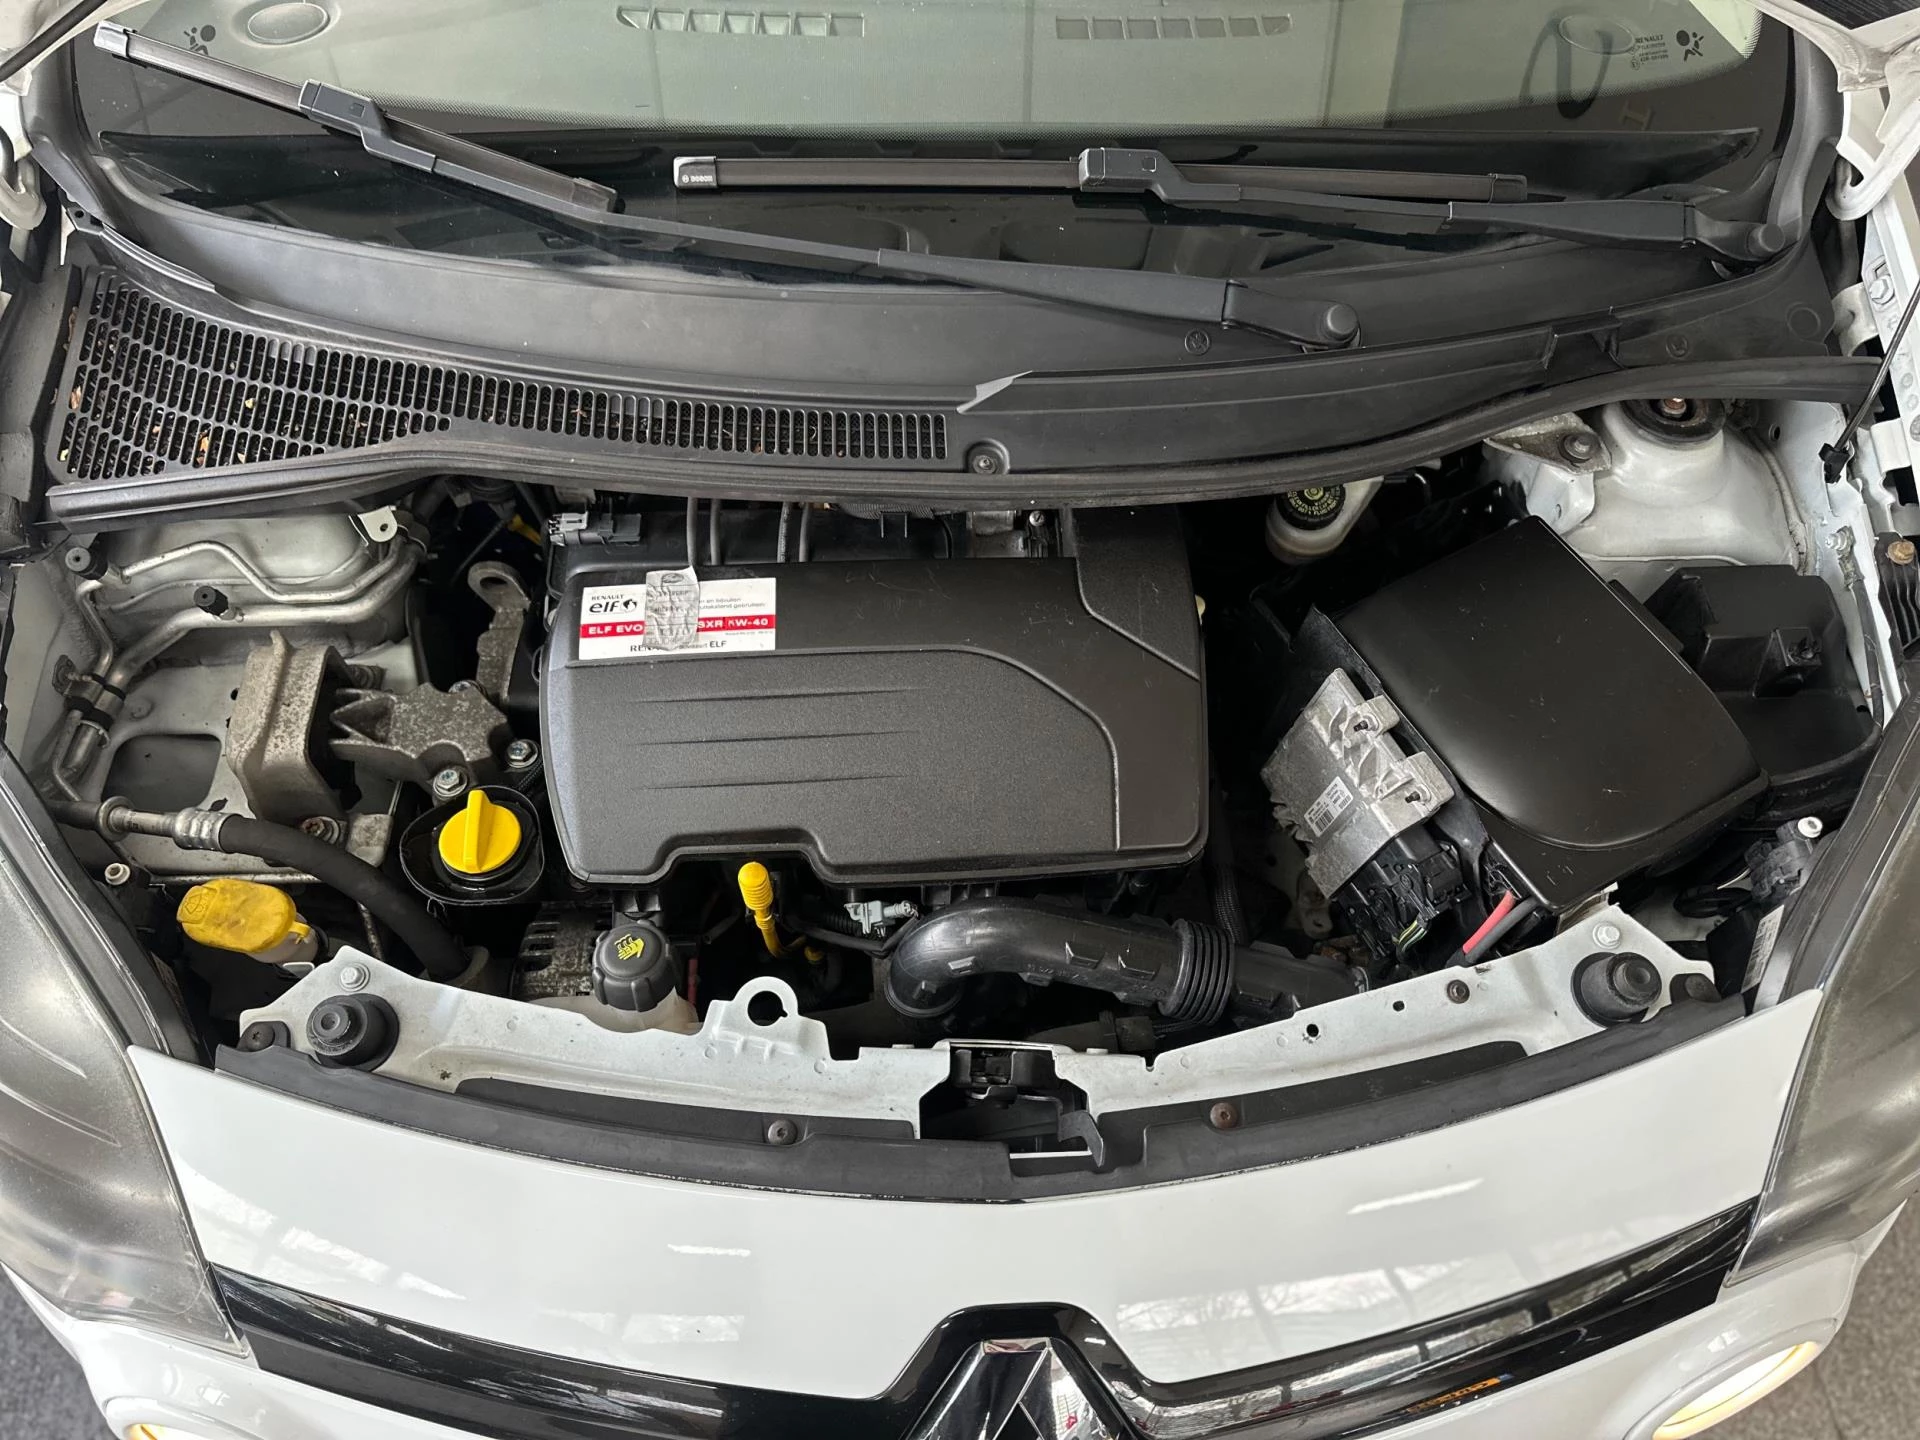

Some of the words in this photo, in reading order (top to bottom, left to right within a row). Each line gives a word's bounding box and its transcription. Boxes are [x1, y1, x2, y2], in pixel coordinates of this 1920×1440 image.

[589, 600, 620, 613] elf
[588, 625, 612, 635] ELF
[709, 640, 727, 648] ELF
